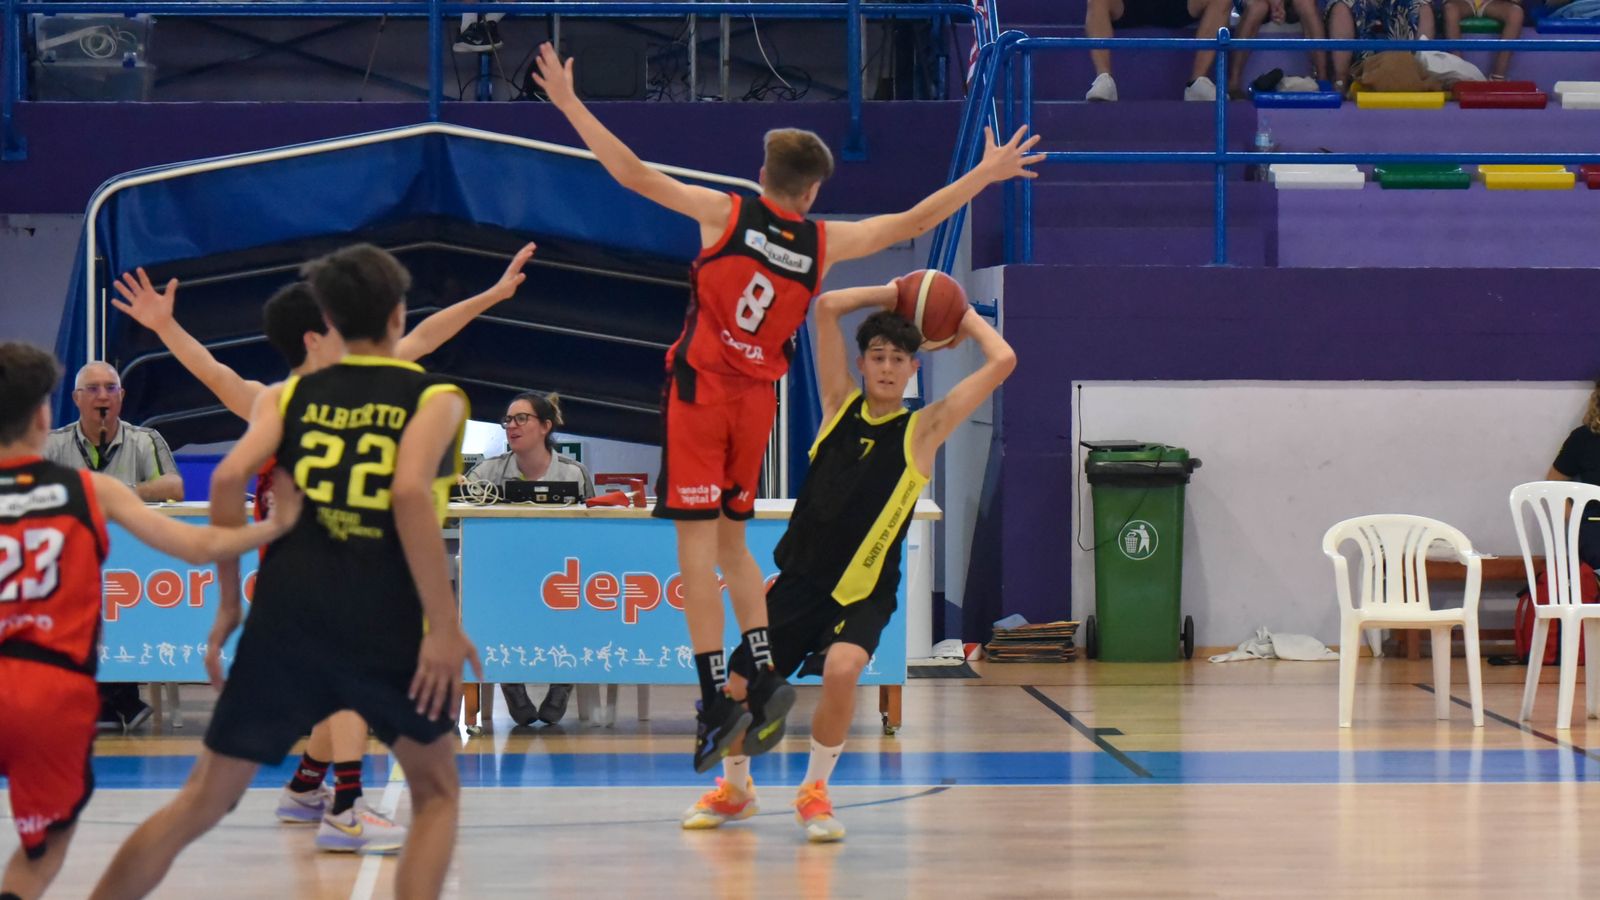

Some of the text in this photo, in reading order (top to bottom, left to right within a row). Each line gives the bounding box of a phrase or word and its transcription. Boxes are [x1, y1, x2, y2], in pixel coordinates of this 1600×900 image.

[736, 271, 776, 335] 8
[301, 403, 407, 430] ALBERTO
[294, 430, 397, 510] 22
[860, 437, 875, 460] 7
